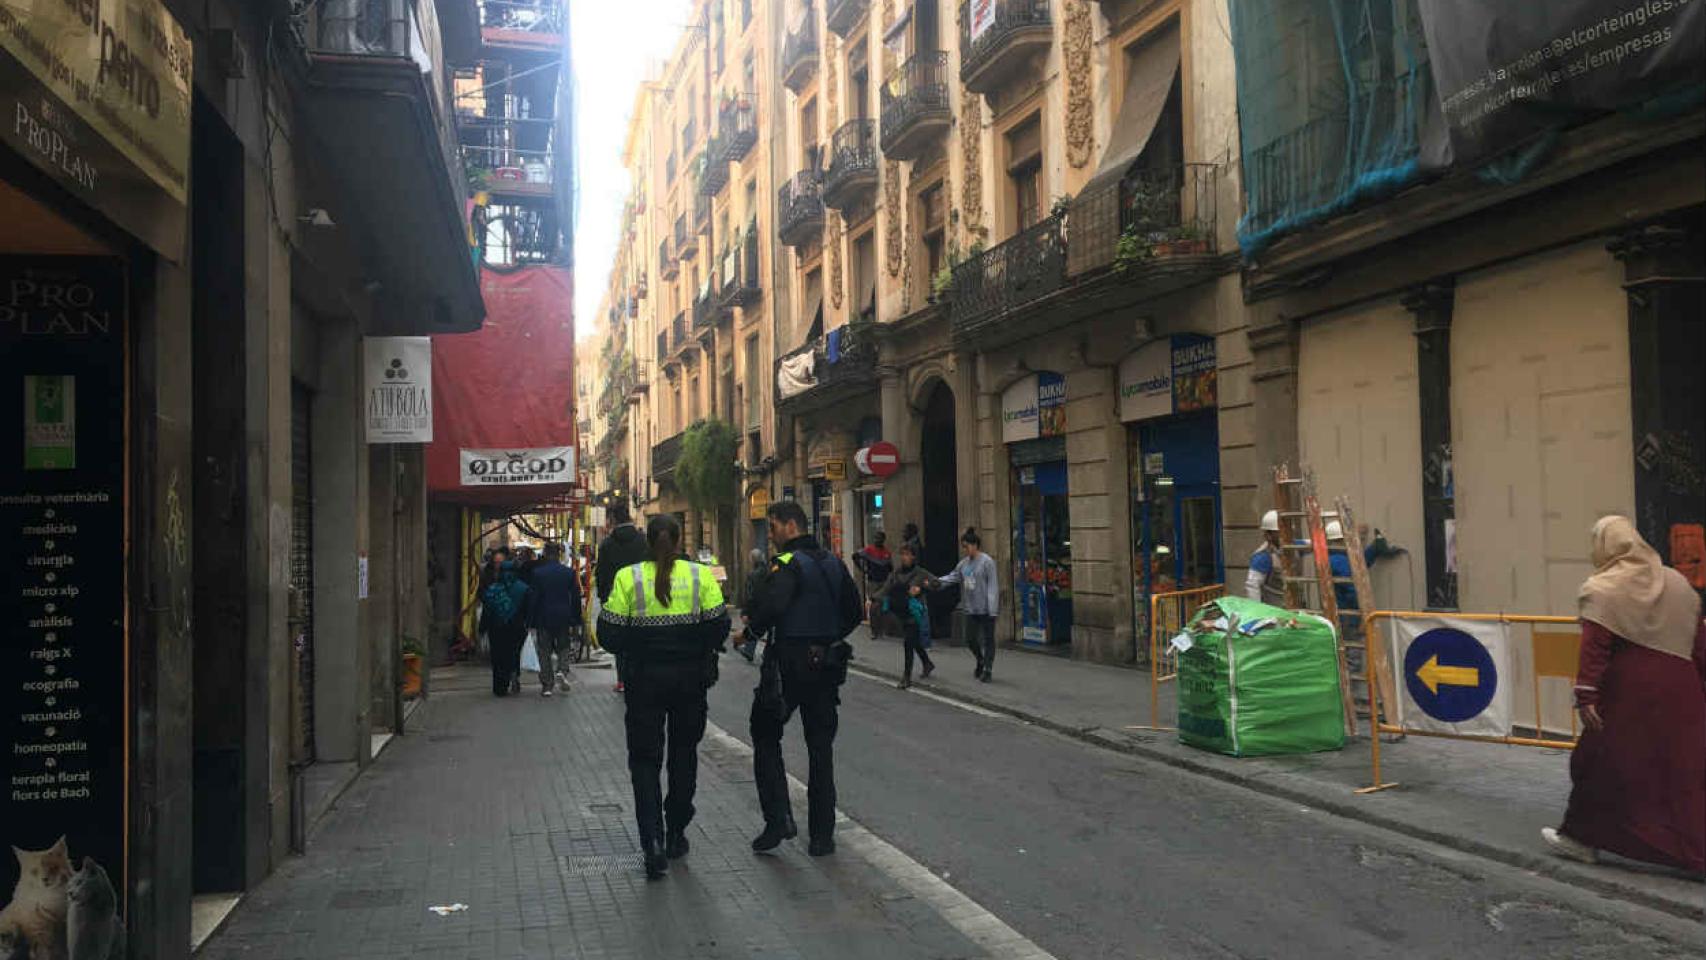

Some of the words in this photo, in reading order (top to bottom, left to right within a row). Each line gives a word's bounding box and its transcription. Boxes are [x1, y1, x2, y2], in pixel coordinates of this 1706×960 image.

[9, 279, 95, 309] PRO
[469, 457, 566, 476] ØLGOD
[22, 523, 77, 535] medicina
[27, 553, 74, 568] cirurgia
[22, 585, 57, 597] micro
[60, 583, 79, 598] xip
[30, 647, 61, 661] raigs
[63, 647, 72, 658] X
[22, 678, 80, 693] ecografia
[21, 708, 81, 721] vacunació
[14, 741, 87, 755] homeopatia
[58, 771, 90, 783] floral
[12, 788, 40, 801] flors
[42, 786, 58, 799] de
[60, 786, 90, 799] Bach
